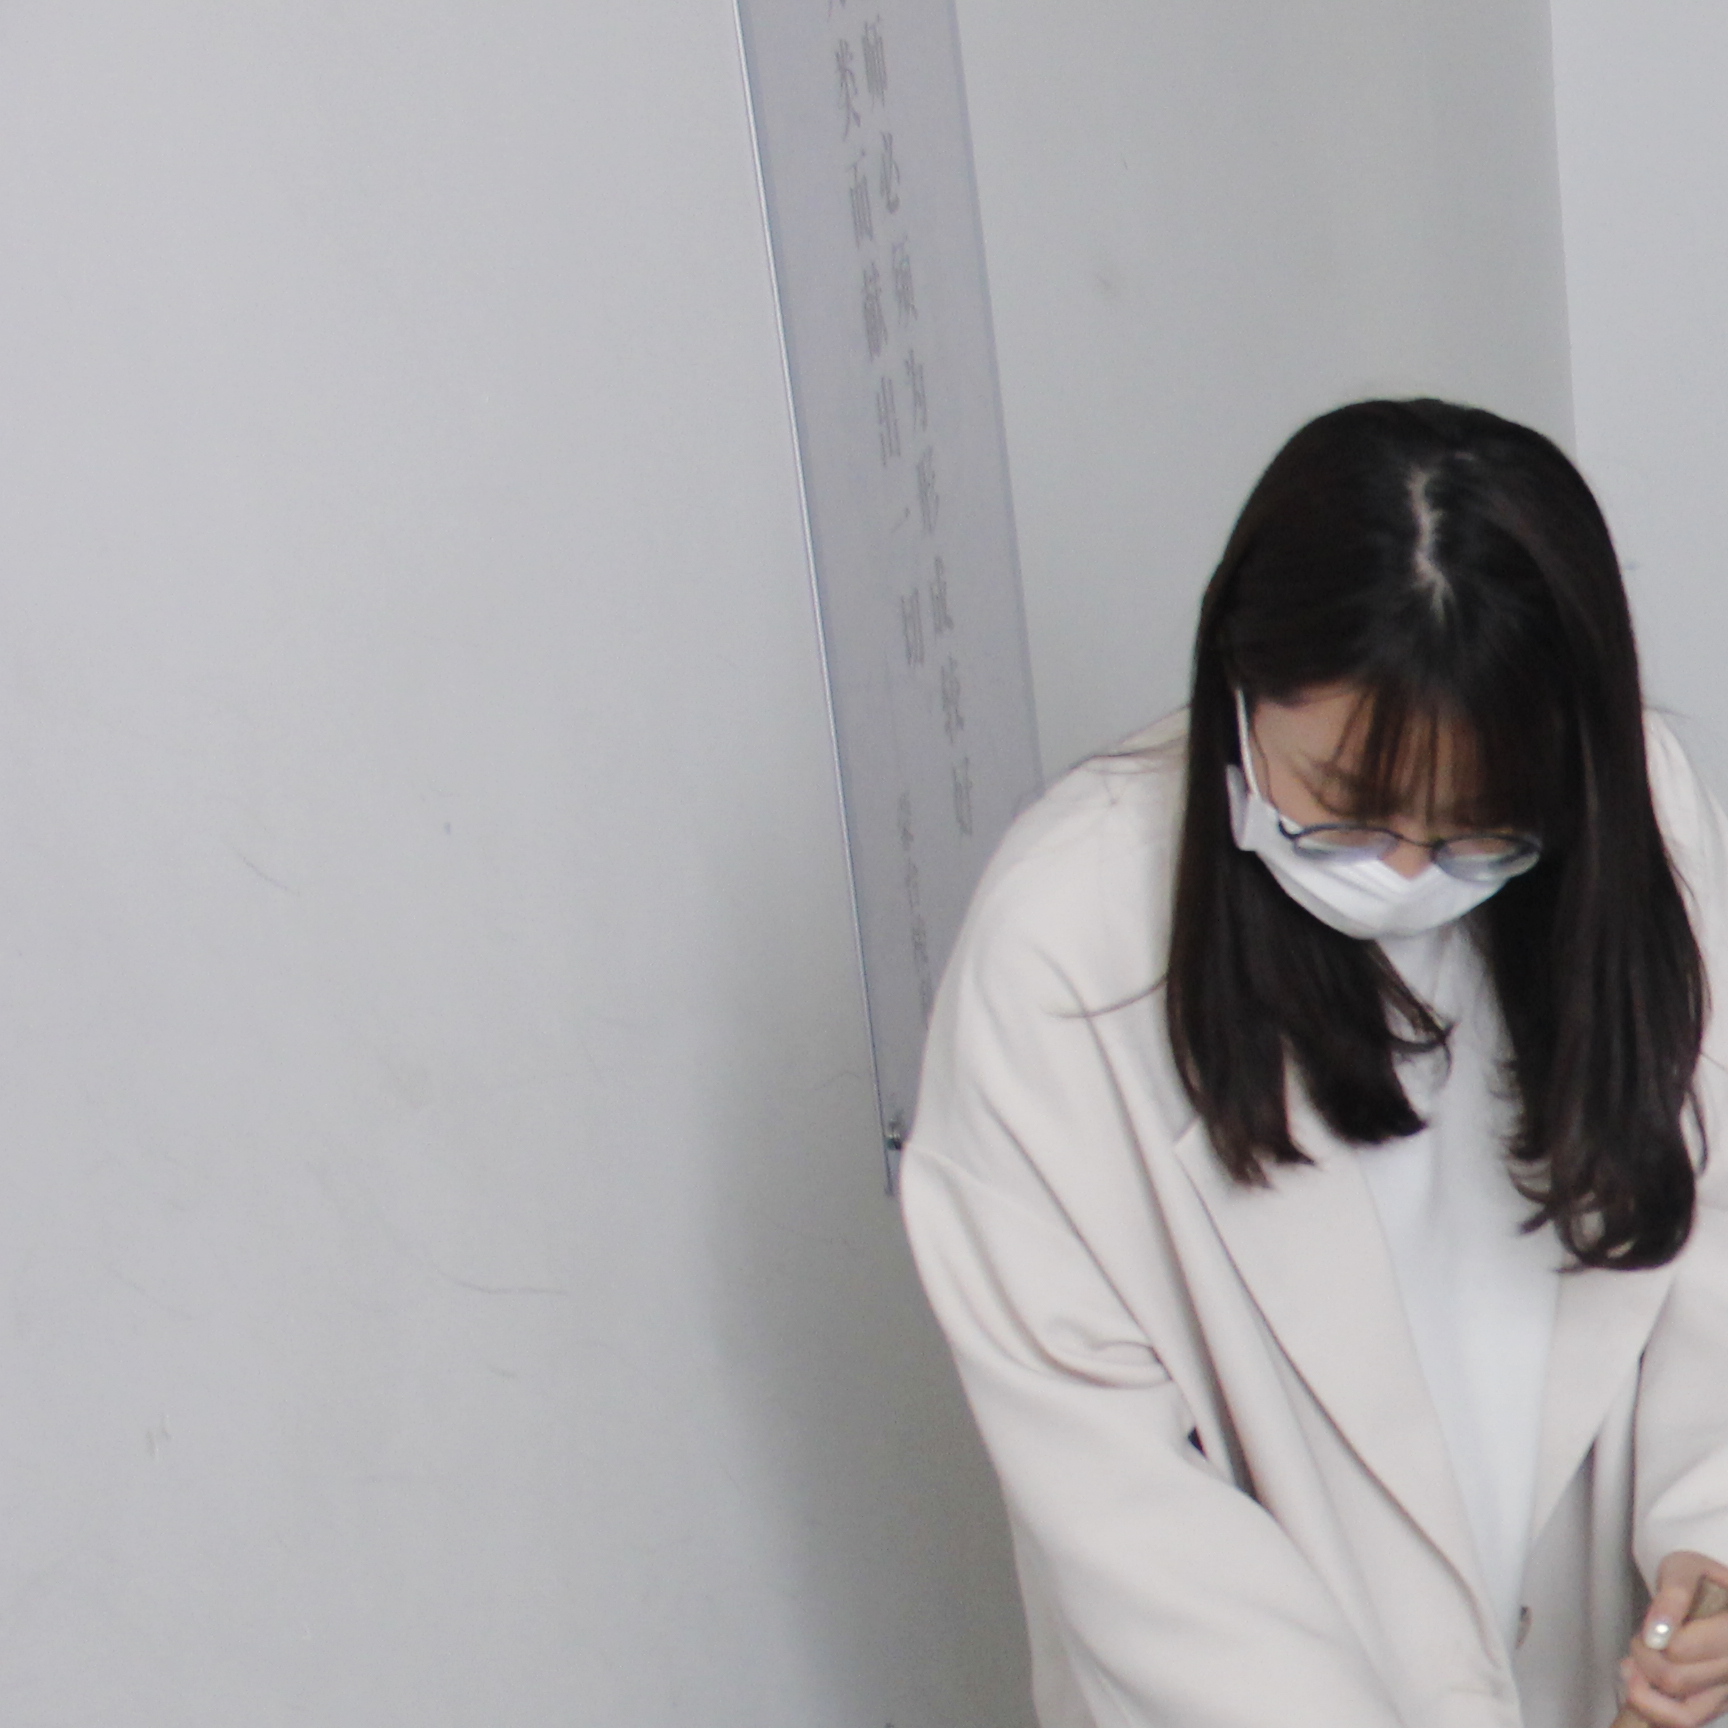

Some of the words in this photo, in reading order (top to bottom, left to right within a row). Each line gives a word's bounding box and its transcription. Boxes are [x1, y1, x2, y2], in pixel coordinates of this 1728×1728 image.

[827, 0, 925, 669] 类而献出一切
